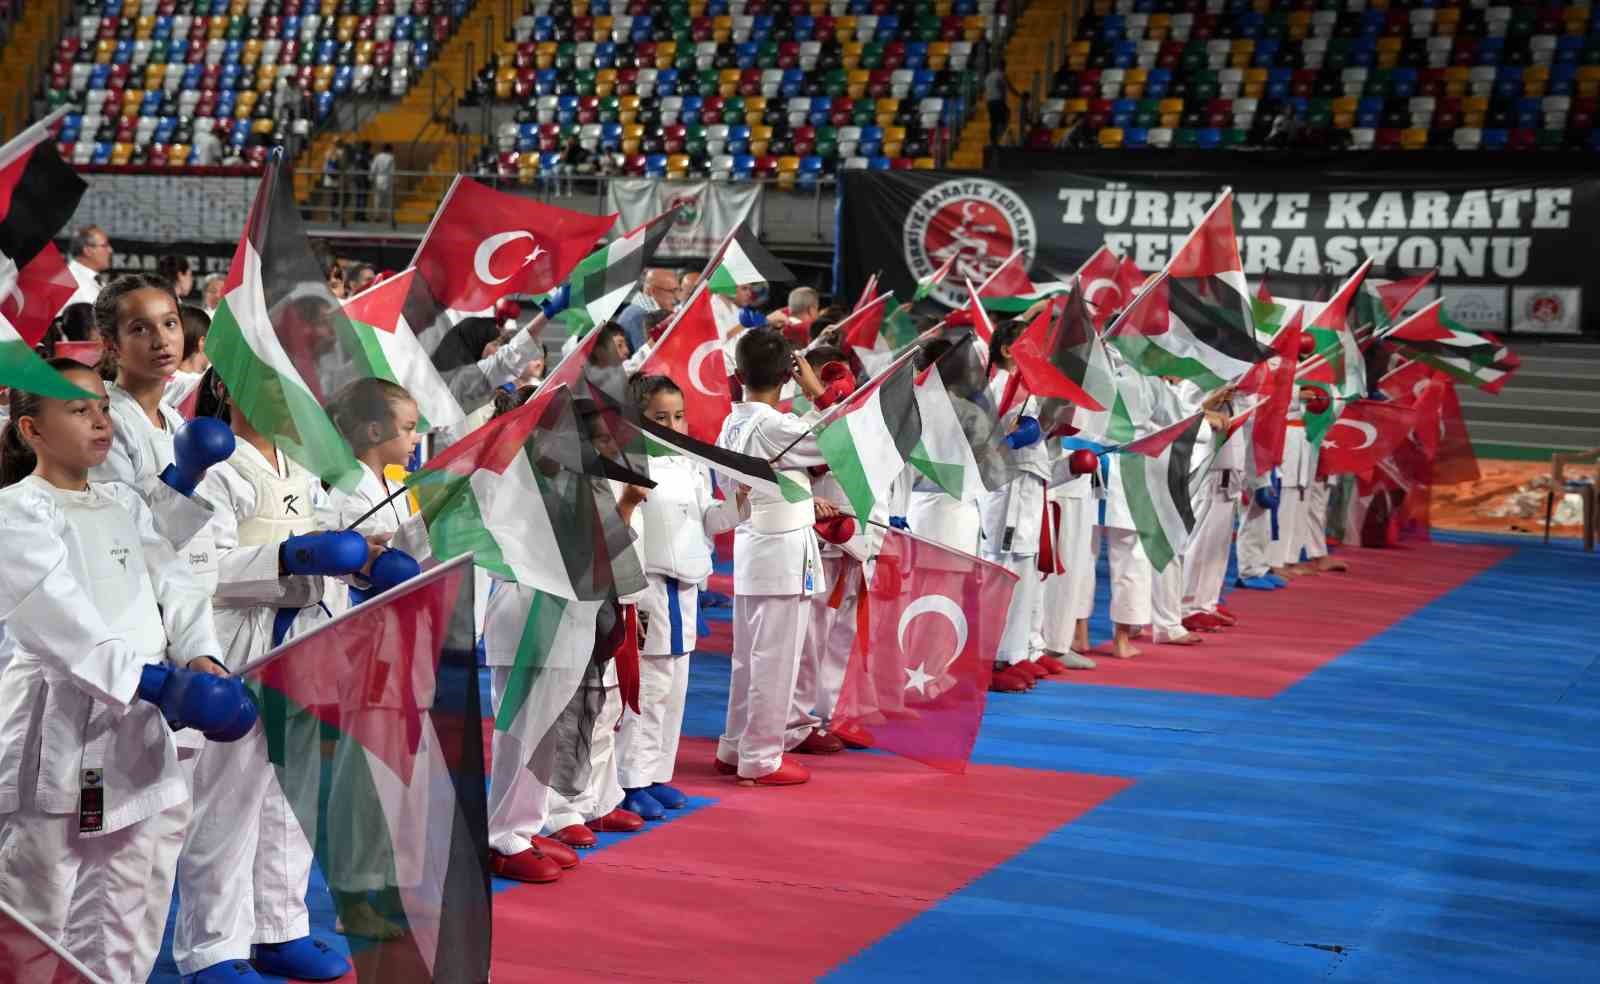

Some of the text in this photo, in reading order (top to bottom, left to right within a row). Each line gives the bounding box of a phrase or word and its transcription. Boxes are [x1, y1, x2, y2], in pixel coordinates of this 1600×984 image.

[1058, 182, 1573, 229] TÜRKYE KARATE
[111, 253, 200, 271] KARE
[1103, 233, 1532, 278] FERASYONU
